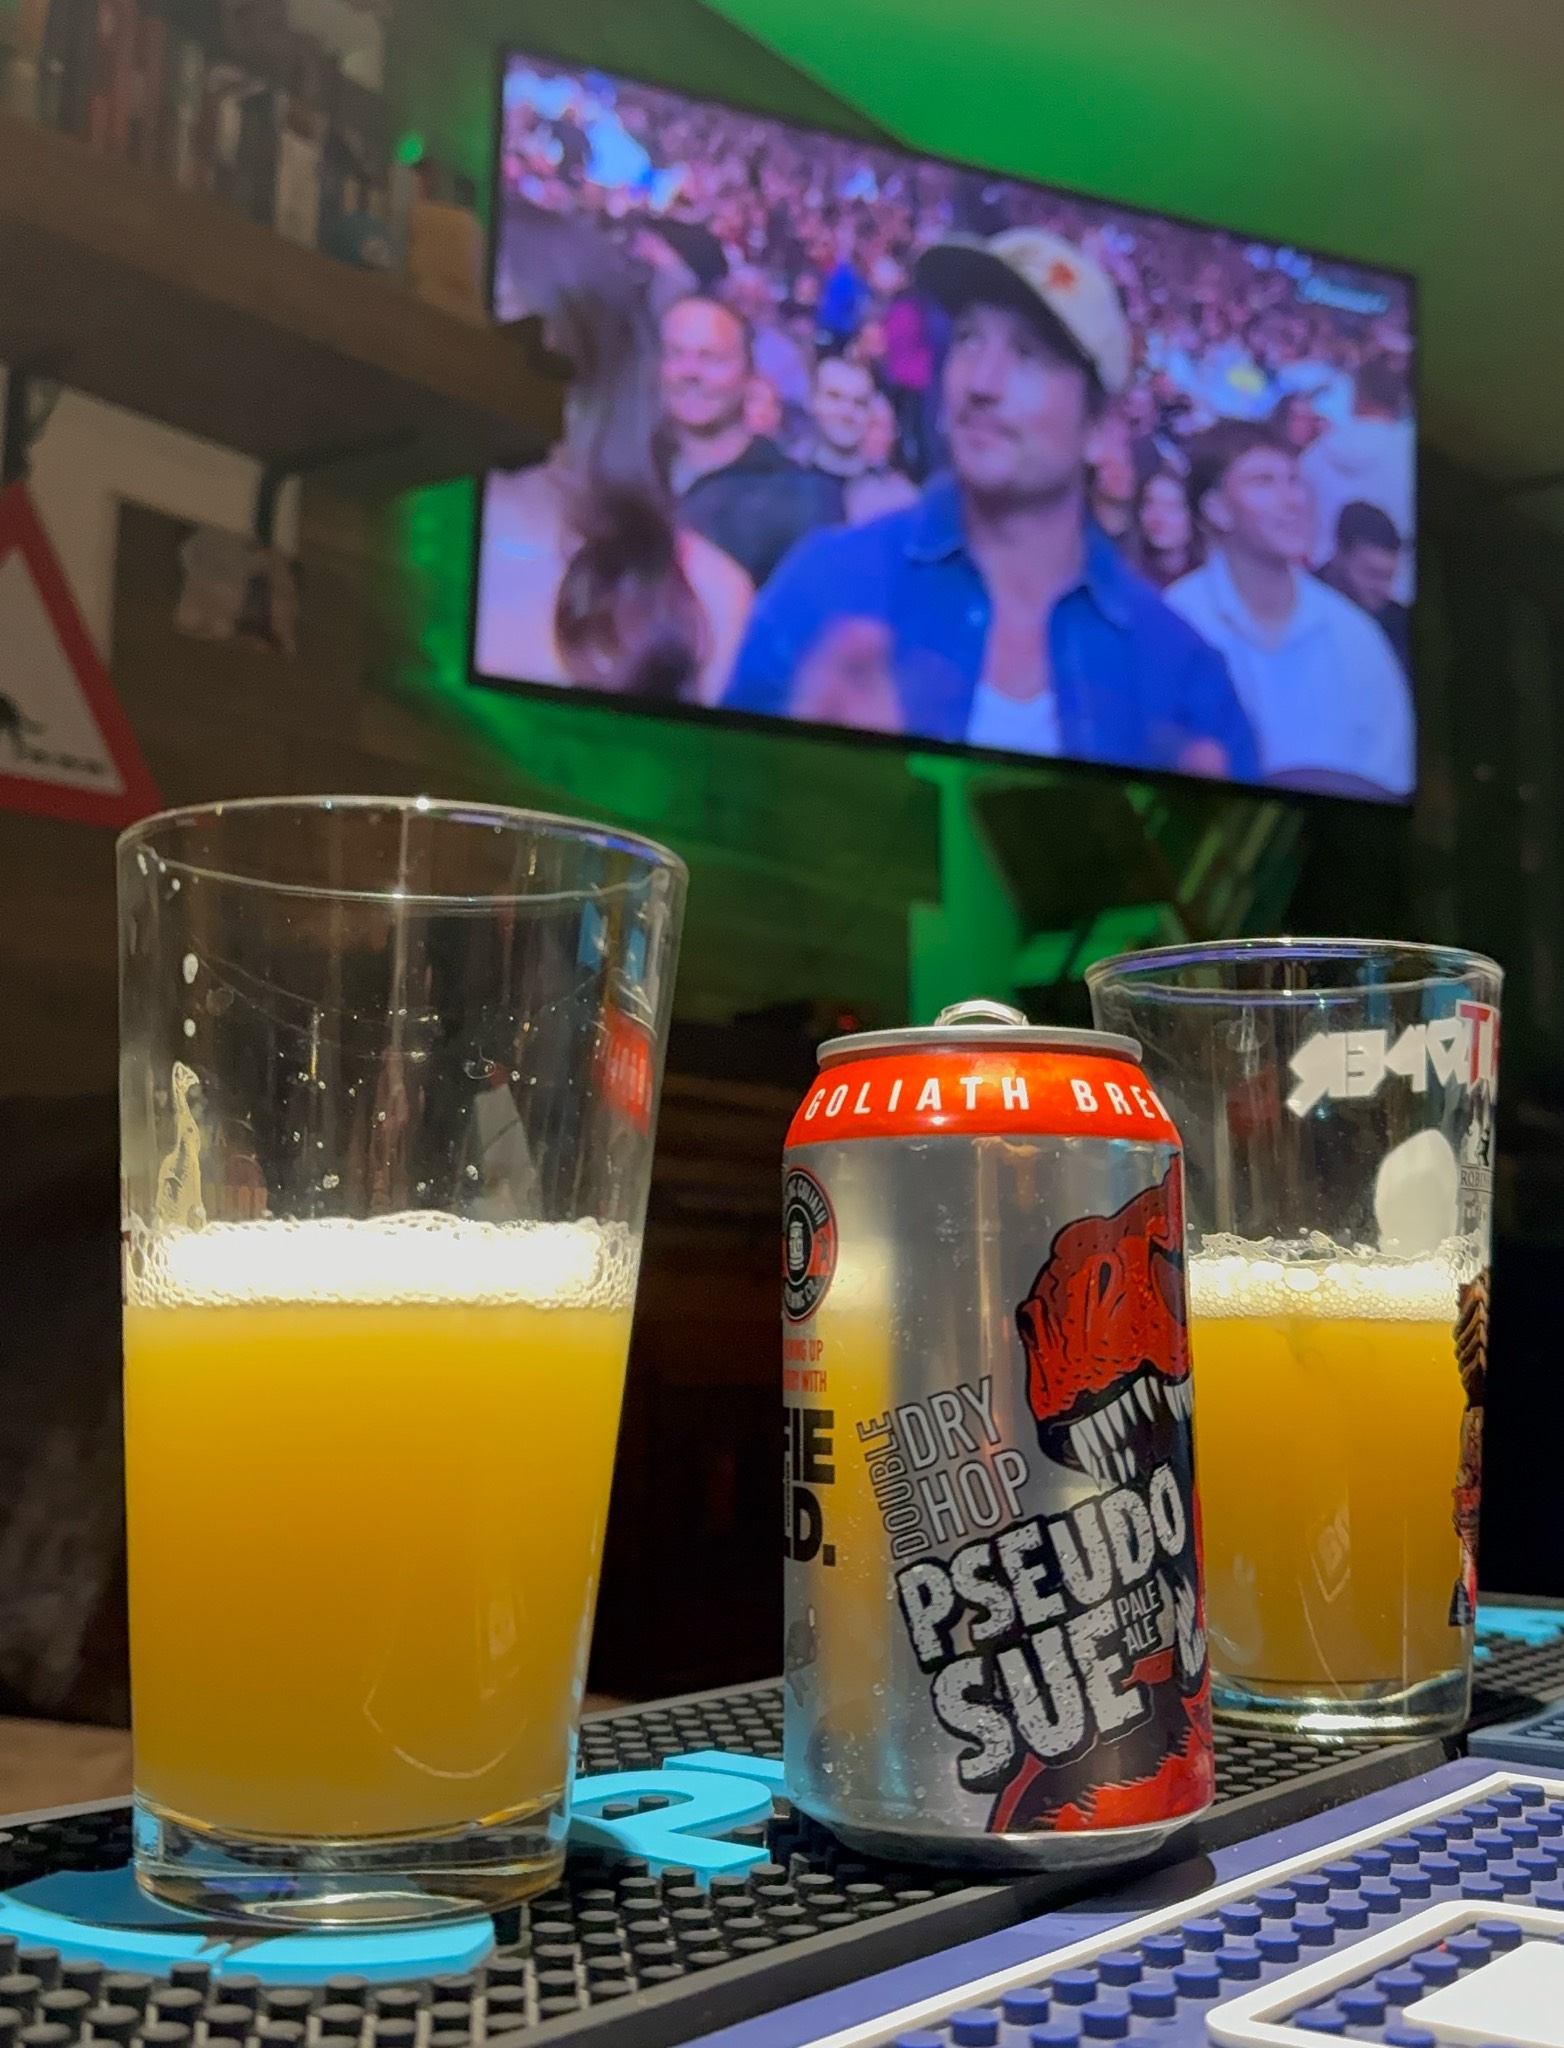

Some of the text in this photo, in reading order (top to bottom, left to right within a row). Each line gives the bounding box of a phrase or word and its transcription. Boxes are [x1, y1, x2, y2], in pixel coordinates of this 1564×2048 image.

[804, 1077, 1030, 1122] GOLIATH
[802, 1369, 827, 1393] WITH
[808, 1338, 824, 1362] UP
[900, 1376, 1002, 1471] DRY
[857, 1411, 929, 1560] DOUBLE
[917, 1449, 1030, 1543] HOP
[896, 1460, 1187, 1667] PSEUDO
[1116, 1579, 1161, 1627] PALE
[1121, 1615, 1158, 1655] ALE
[932, 1598, 1146, 1781] SUE
